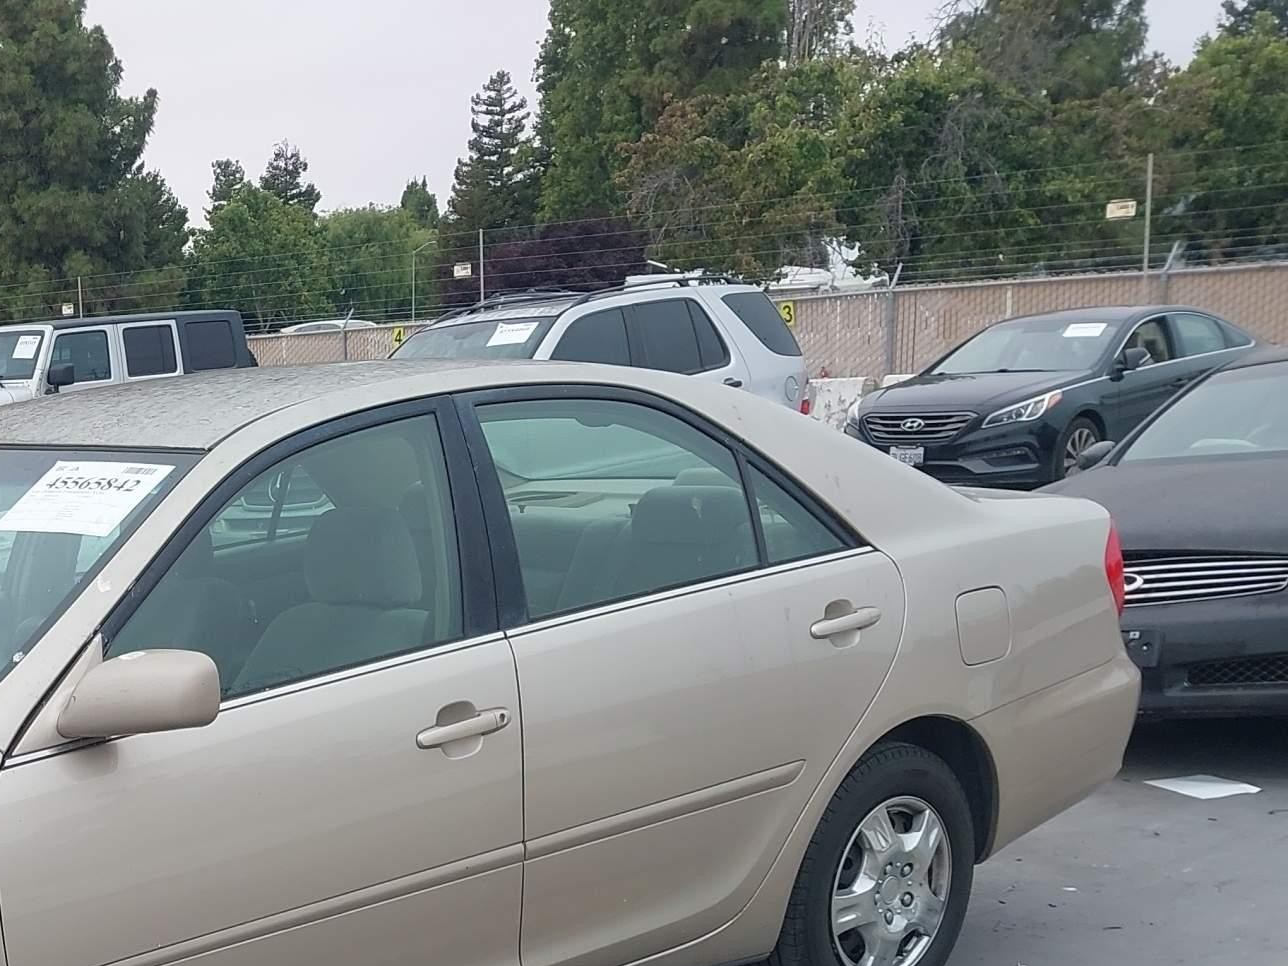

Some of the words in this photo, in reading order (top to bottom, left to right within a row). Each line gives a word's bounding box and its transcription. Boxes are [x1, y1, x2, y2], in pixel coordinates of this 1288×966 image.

[782, 304, 793, 323] 3
[394, 330, 403, 344] 4
[46, 476, 141, 492] 45565842
